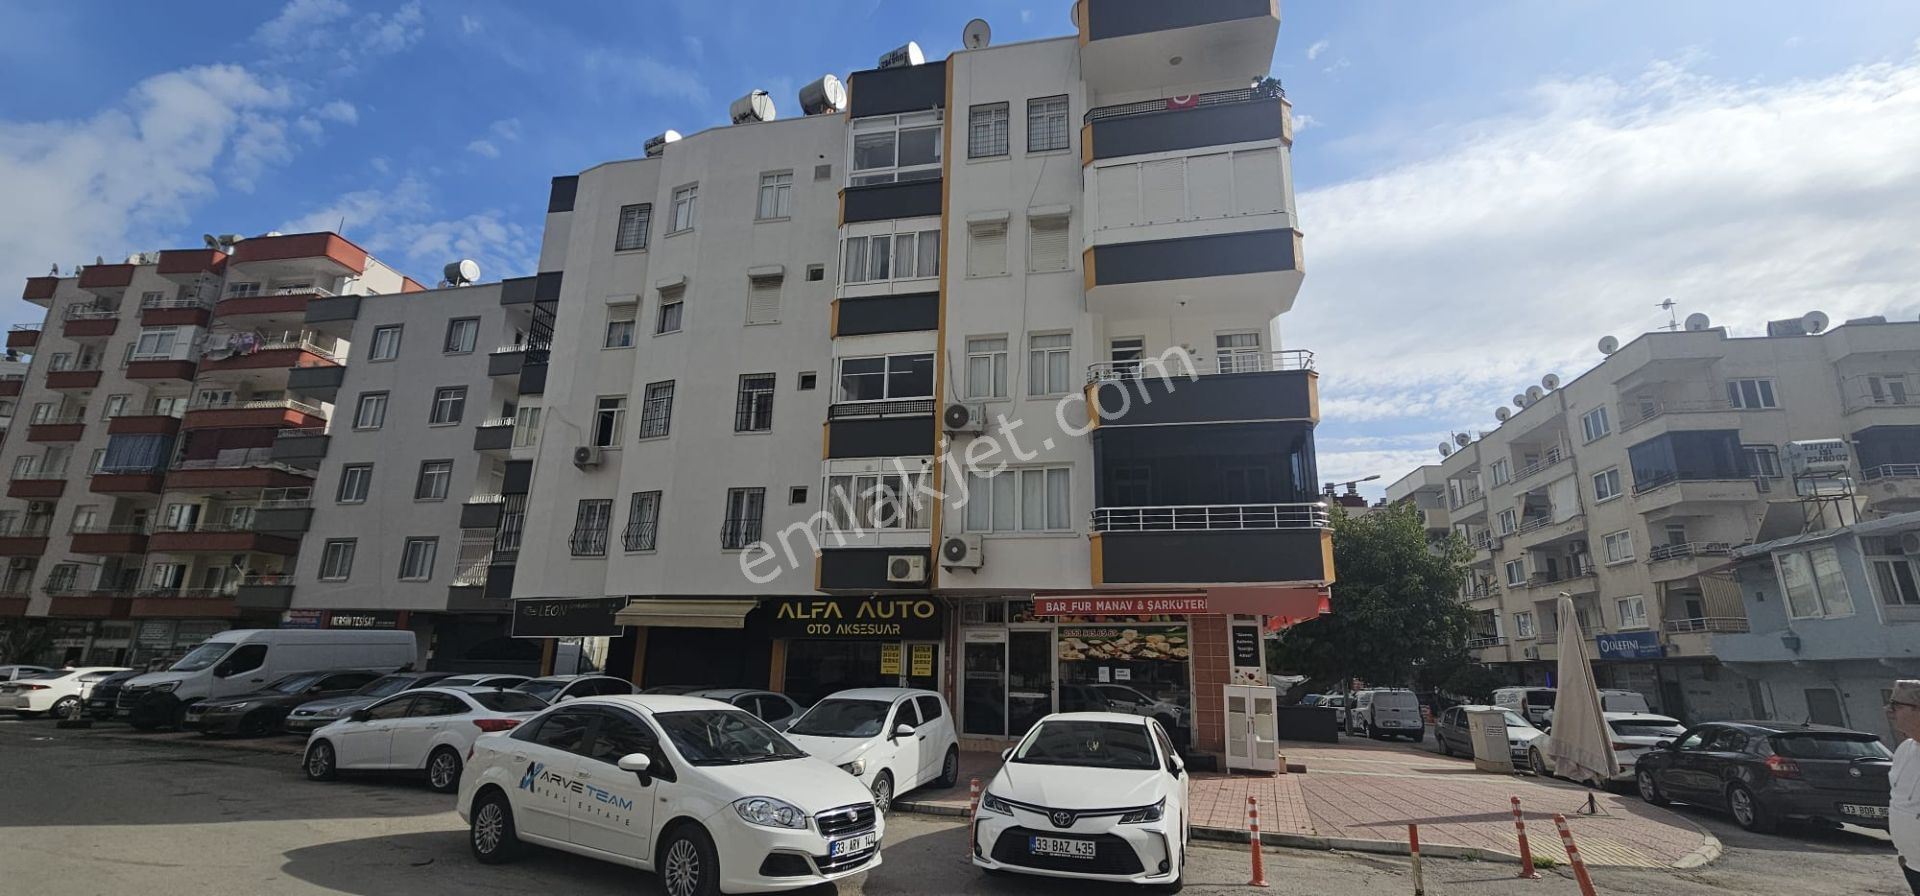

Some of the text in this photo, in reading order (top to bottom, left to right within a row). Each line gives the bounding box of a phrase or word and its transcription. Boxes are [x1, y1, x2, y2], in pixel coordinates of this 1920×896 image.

[777, 600, 935, 619] ALFA AUTO
[1096, 600, 1133, 611] MANAV
[1137, 600, 1144, 610] &
[807, 623, 901, 635] OTO AKSESUAR
[540, 770, 633, 811] ARVE TEAM
[578, 801, 630, 826] ESTATE
[835, 842, 845, 854] 33
[1036, 839, 1094, 855] 33 BAZ 435
